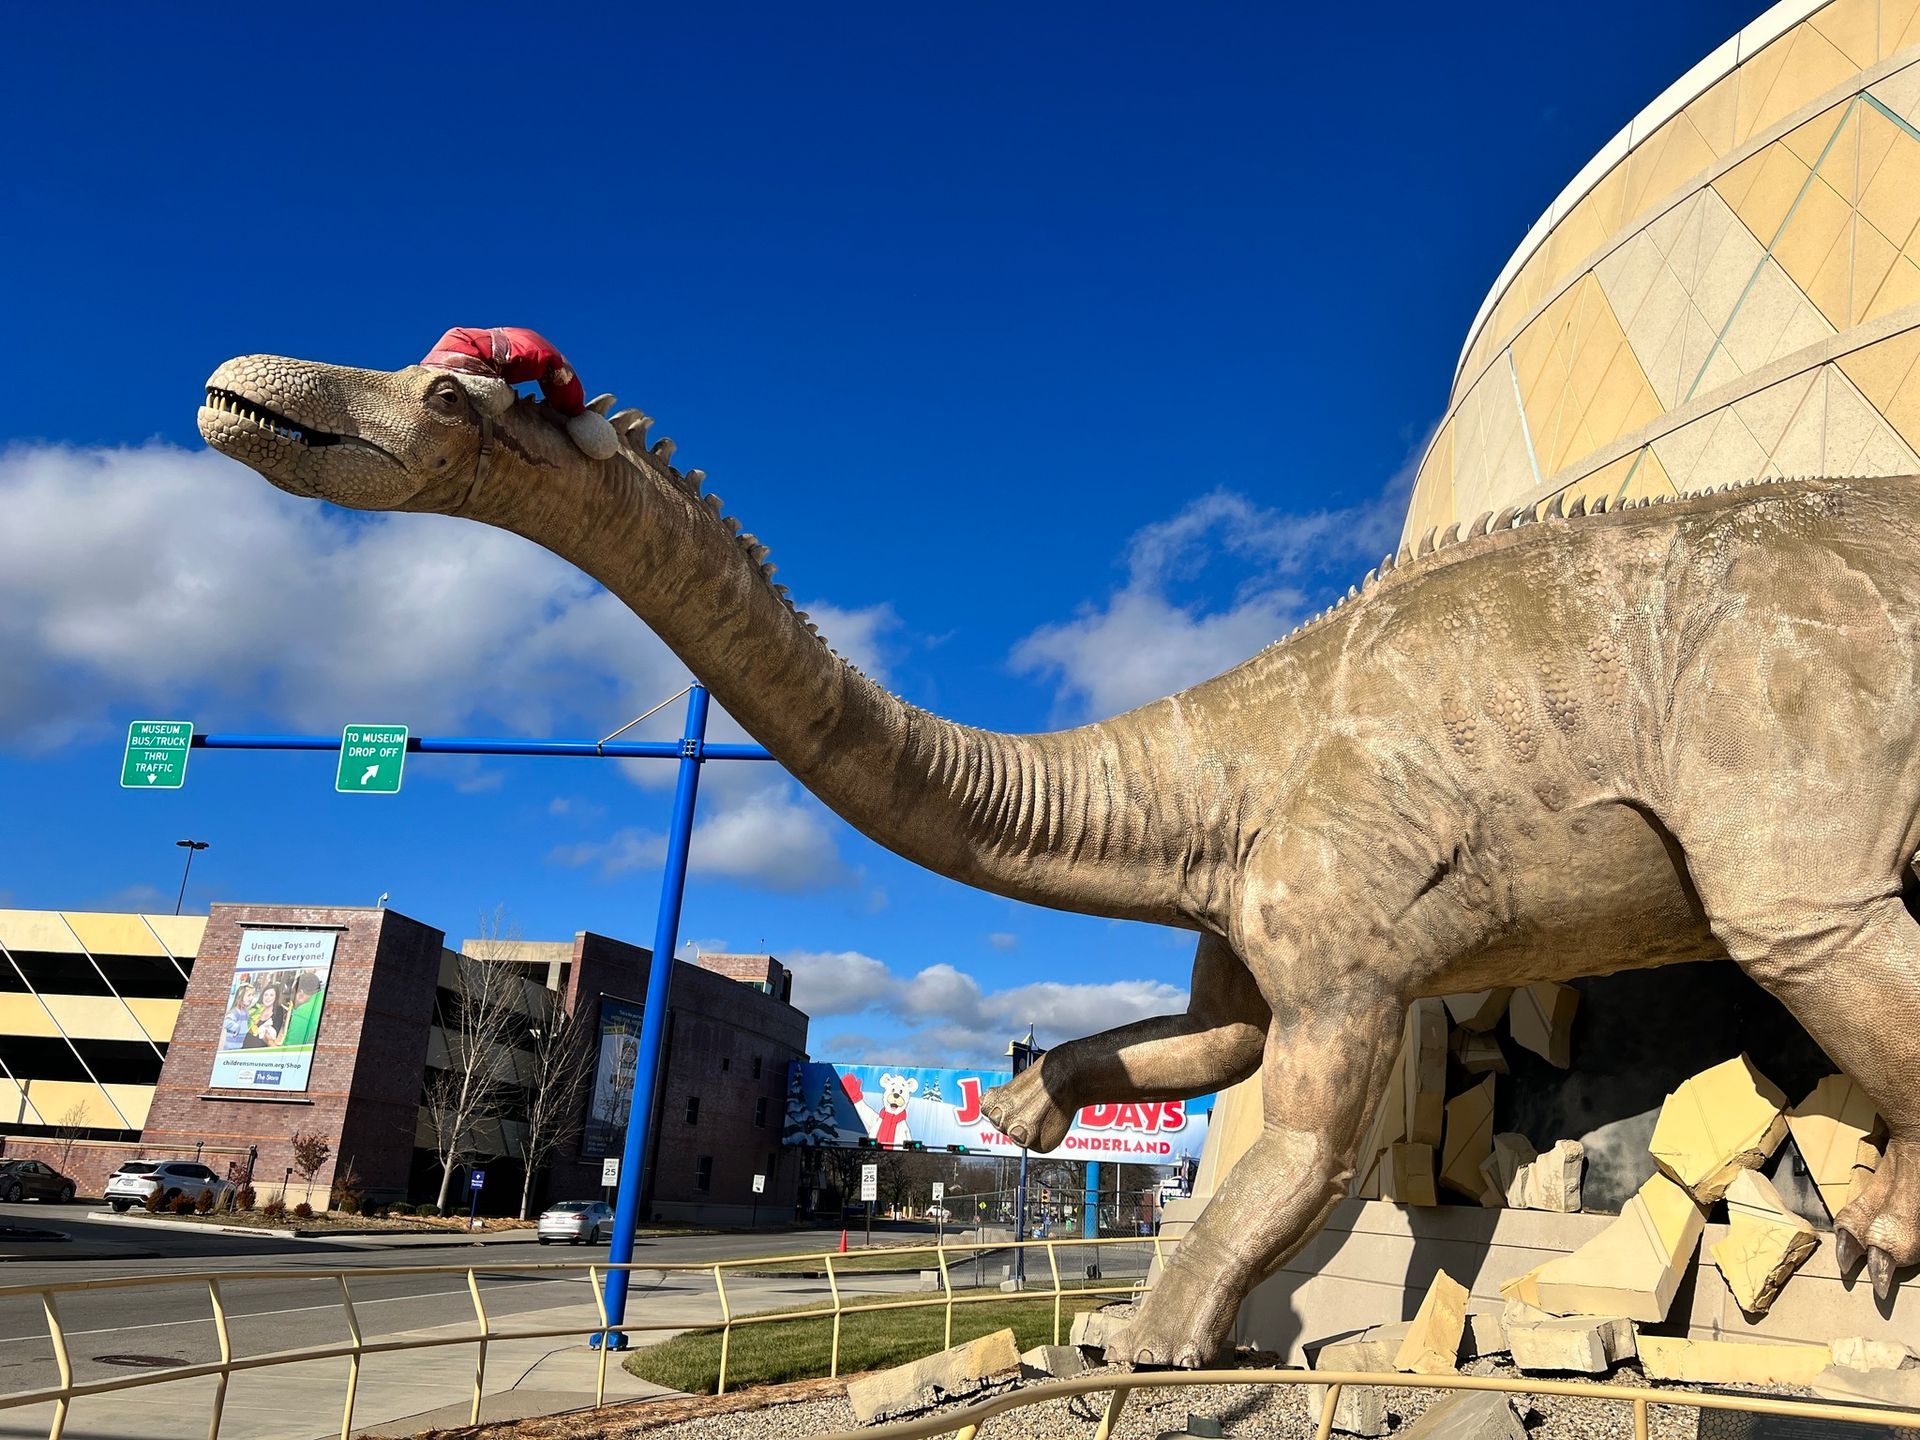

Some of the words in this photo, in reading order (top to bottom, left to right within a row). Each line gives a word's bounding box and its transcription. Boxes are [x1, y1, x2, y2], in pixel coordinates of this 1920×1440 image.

[141, 725, 180, 734] MUSEUM
[131, 736, 186, 746] BUS/TRUCK
[347, 733, 359, 742] TO
[362, 733, 404, 743] MUSEUM
[144, 752, 169, 761] THRU
[348, 747, 376, 757] DROP
[379, 748, 399, 757] OFF
[136, 763, 174, 773] TRAFFIC
[251, 942, 282, 951] Unique
[284, 941, 303, 950] Toys
[304, 940, 321, 948] and
[244, 954, 265, 962] Gifts
[267, 953, 281, 961] for
[281, 952, 325, 962] Everyone!
[1065, 1136, 1171, 1154] ONDERLAND
[604, 1168, 617, 1176] 25
[863, 1174, 876, 1182] 25
